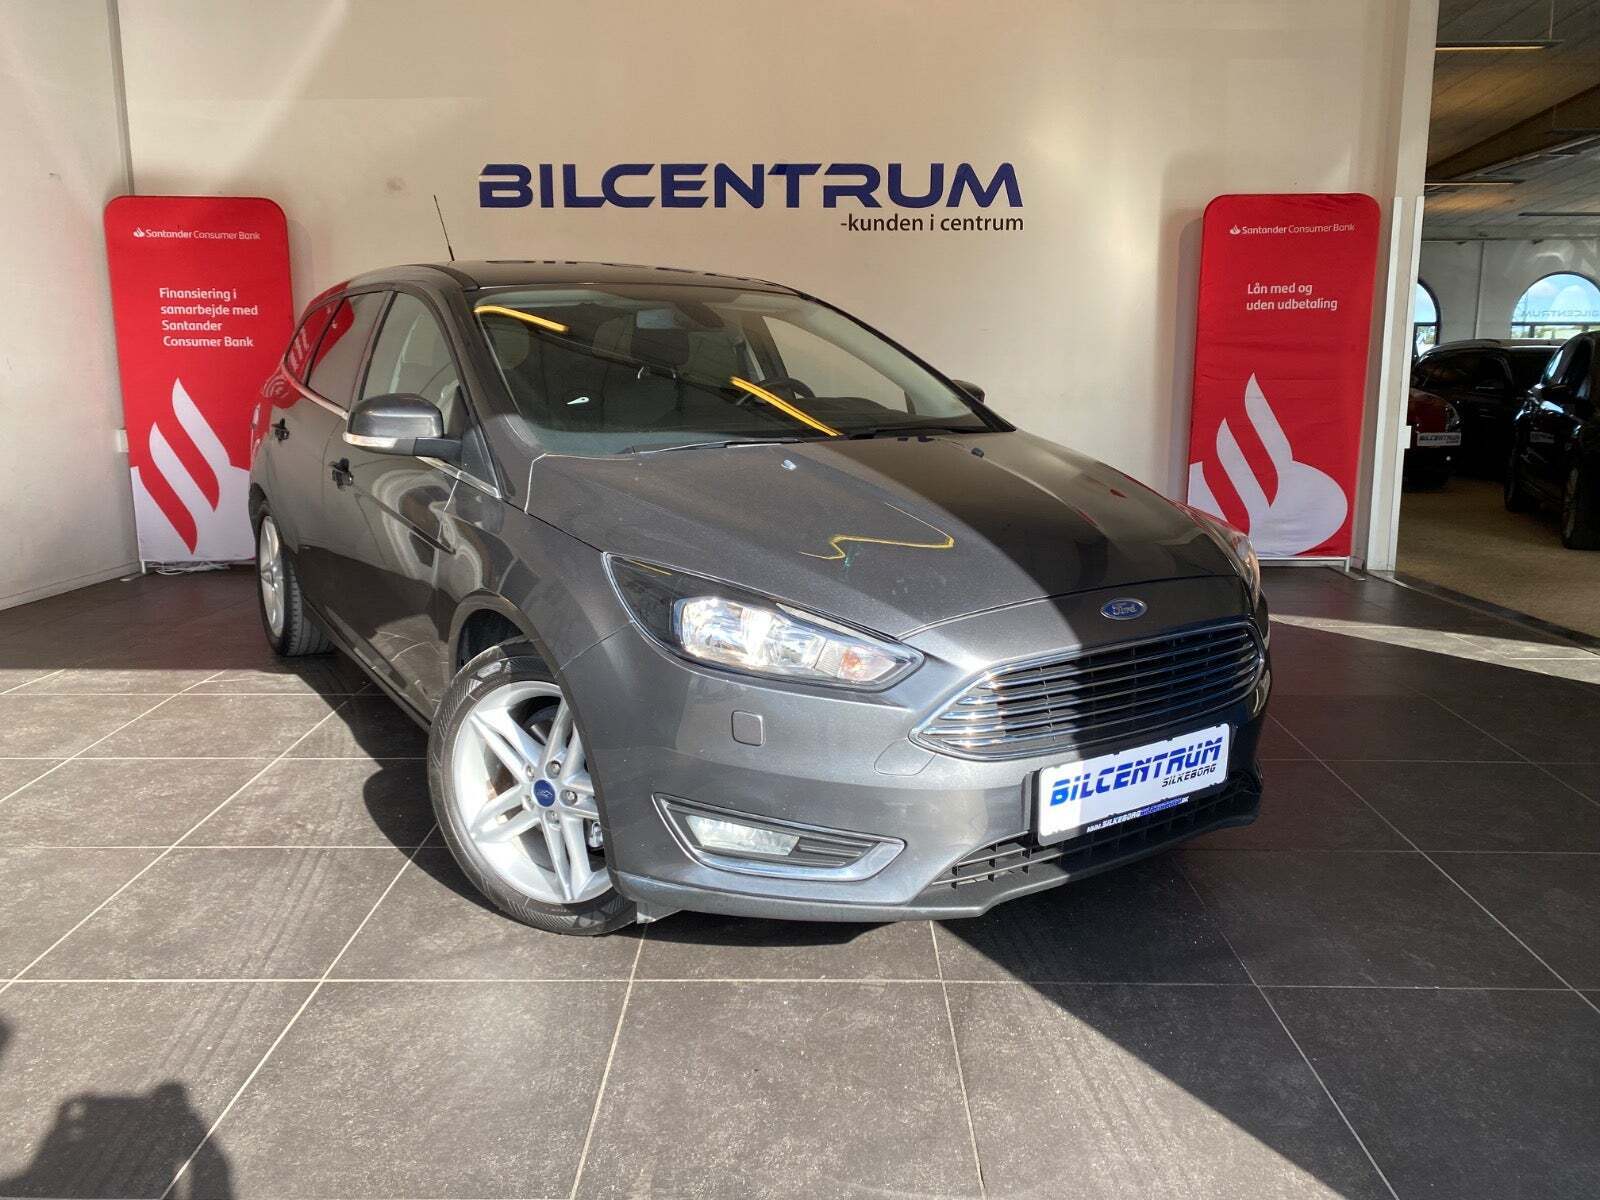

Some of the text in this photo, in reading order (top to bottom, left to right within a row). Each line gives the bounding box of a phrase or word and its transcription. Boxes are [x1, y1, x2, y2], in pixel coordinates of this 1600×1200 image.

[479, 163, 1023, 209] BILCENTRUM
[840, 213, 1024, 232] -kunden i centrum
[145, 229, 260, 240] Santander Consumer Bank
[1241, 223, 1355, 235] Santander Consumer Bank
[159, 287, 237, 302] Finansiering i
[1247, 283, 1313, 295] Lån med og
[1246, 298, 1338, 311] uden udbetaling
[160, 304, 258, 318] samarbejde med
[161, 320, 222, 331] Santander
[163, 336, 254, 347] Consumer Bank
